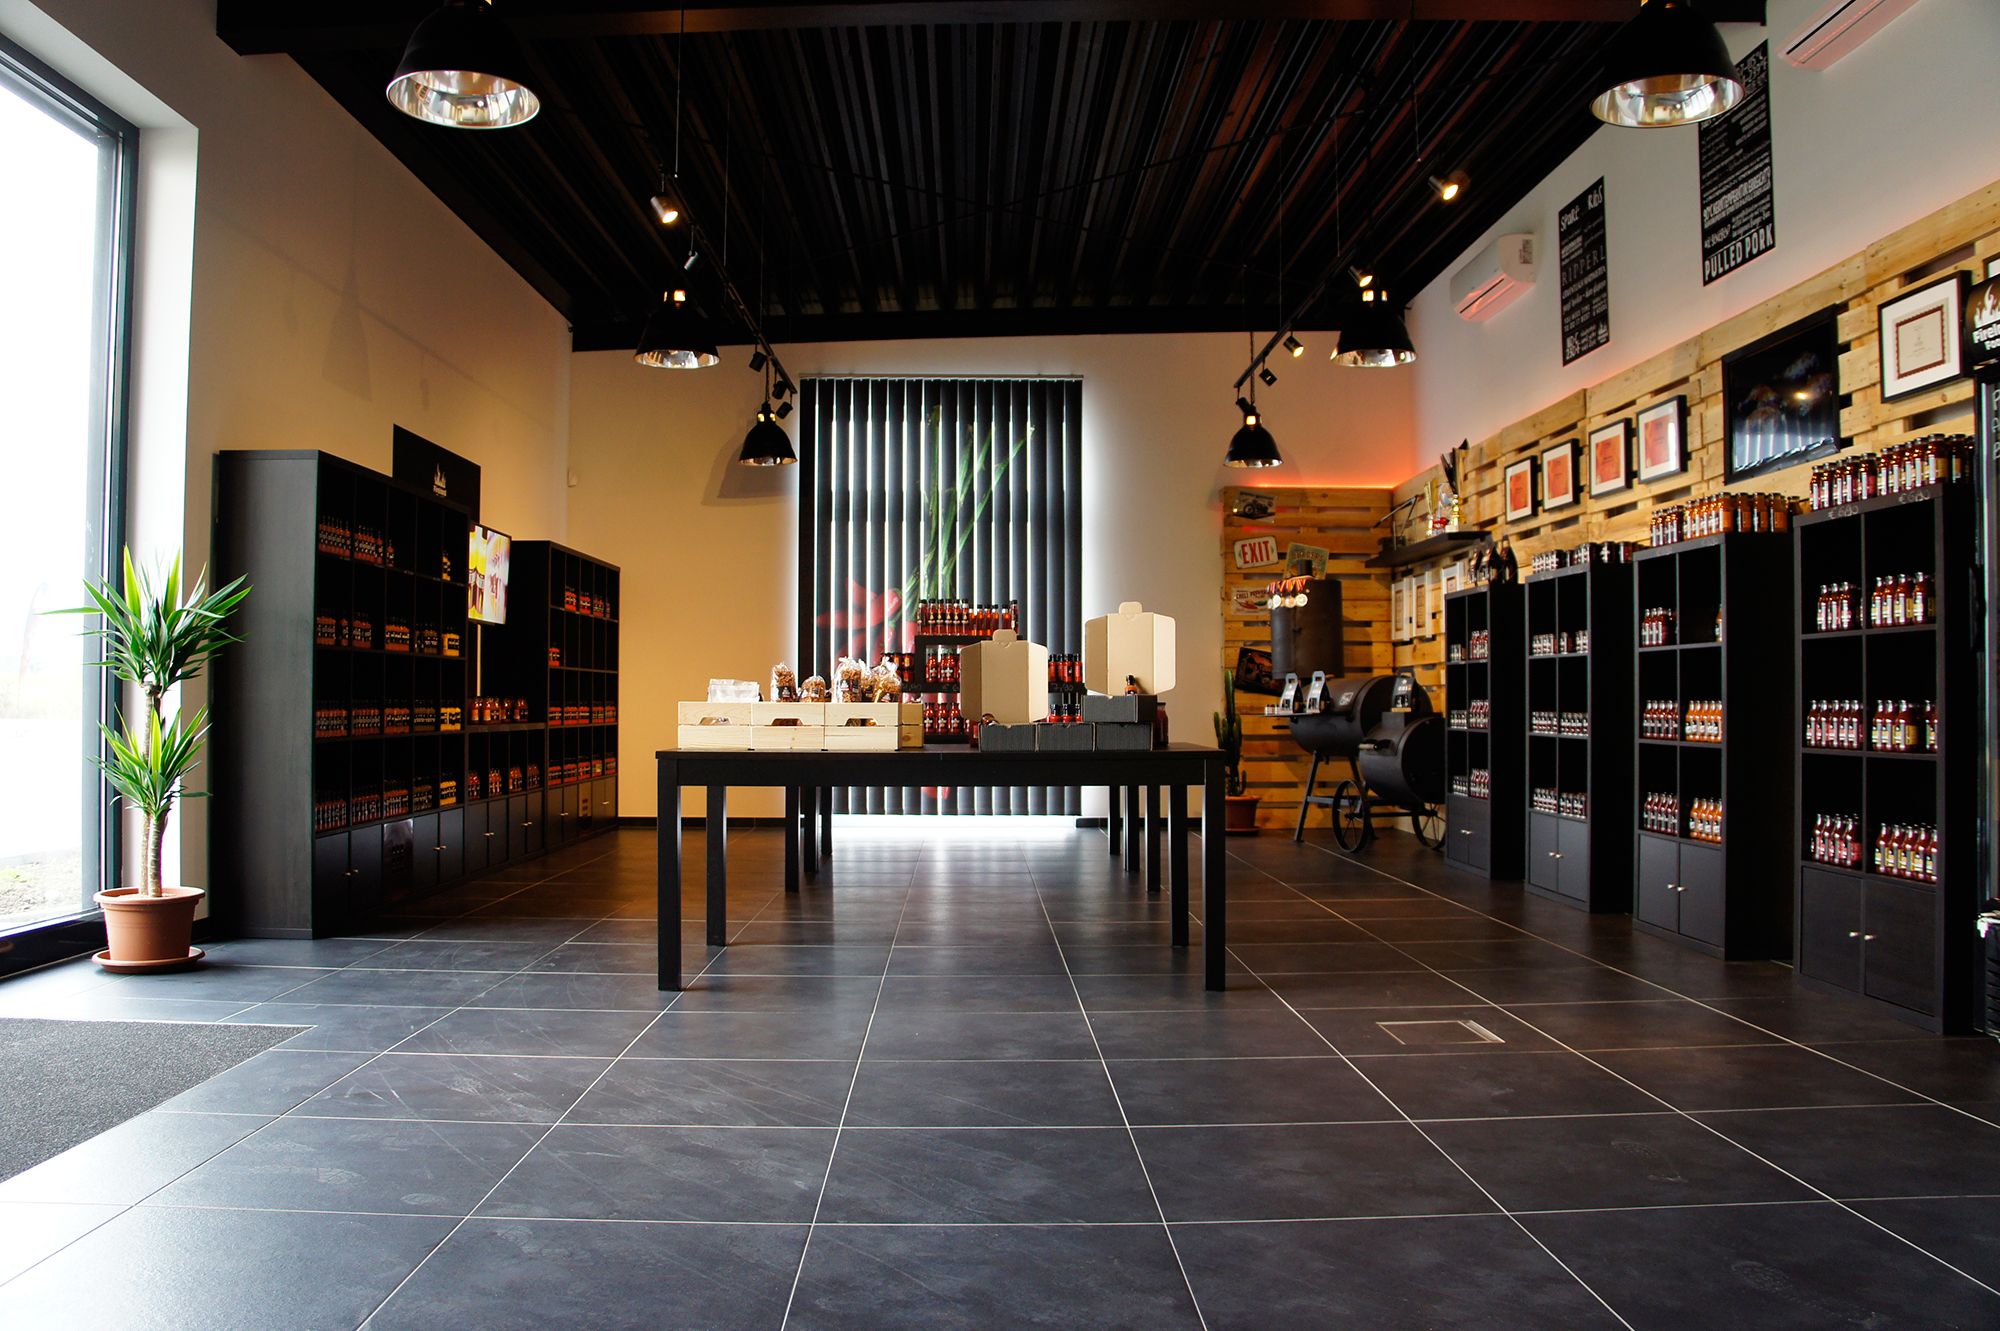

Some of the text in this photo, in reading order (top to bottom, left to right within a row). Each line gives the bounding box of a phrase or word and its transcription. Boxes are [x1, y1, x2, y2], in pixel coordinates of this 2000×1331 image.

[1704, 242, 1743, 281] PULLED
[1745, 223, 1773, 259] PORK
[1241, 541, 1271, 564] EXIT
